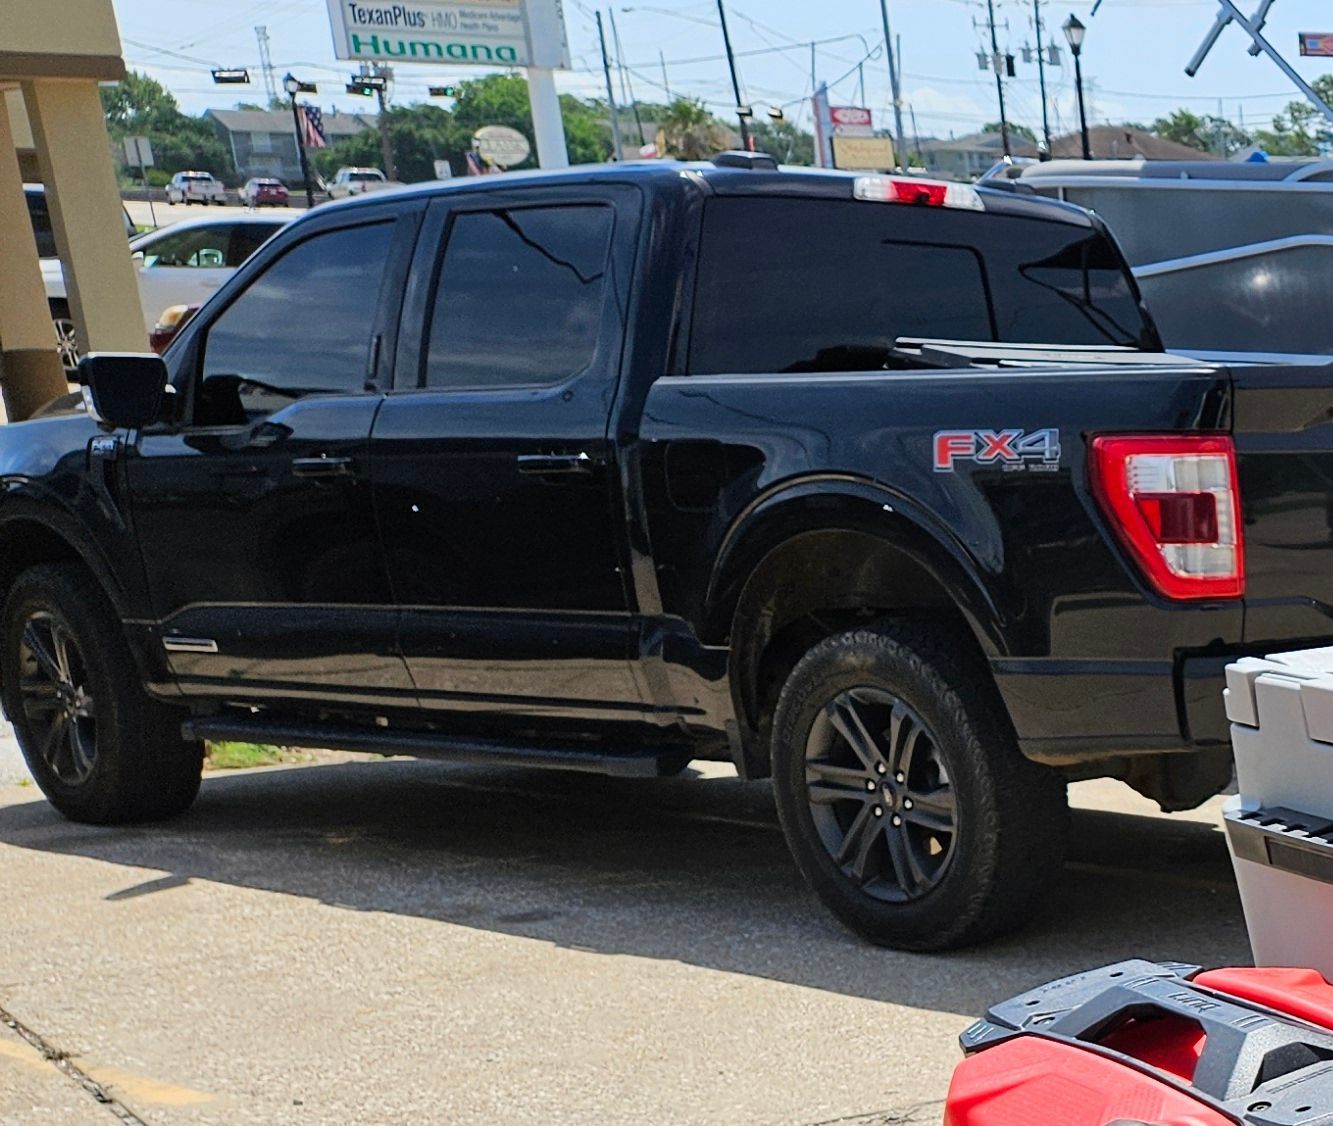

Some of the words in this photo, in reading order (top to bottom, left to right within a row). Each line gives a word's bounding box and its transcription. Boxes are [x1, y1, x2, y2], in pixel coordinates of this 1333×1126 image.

[348, 4, 426, 28] TexanPlus
[352, 34, 518, 62] Humana
[933, 428, 1061, 472] FX4
